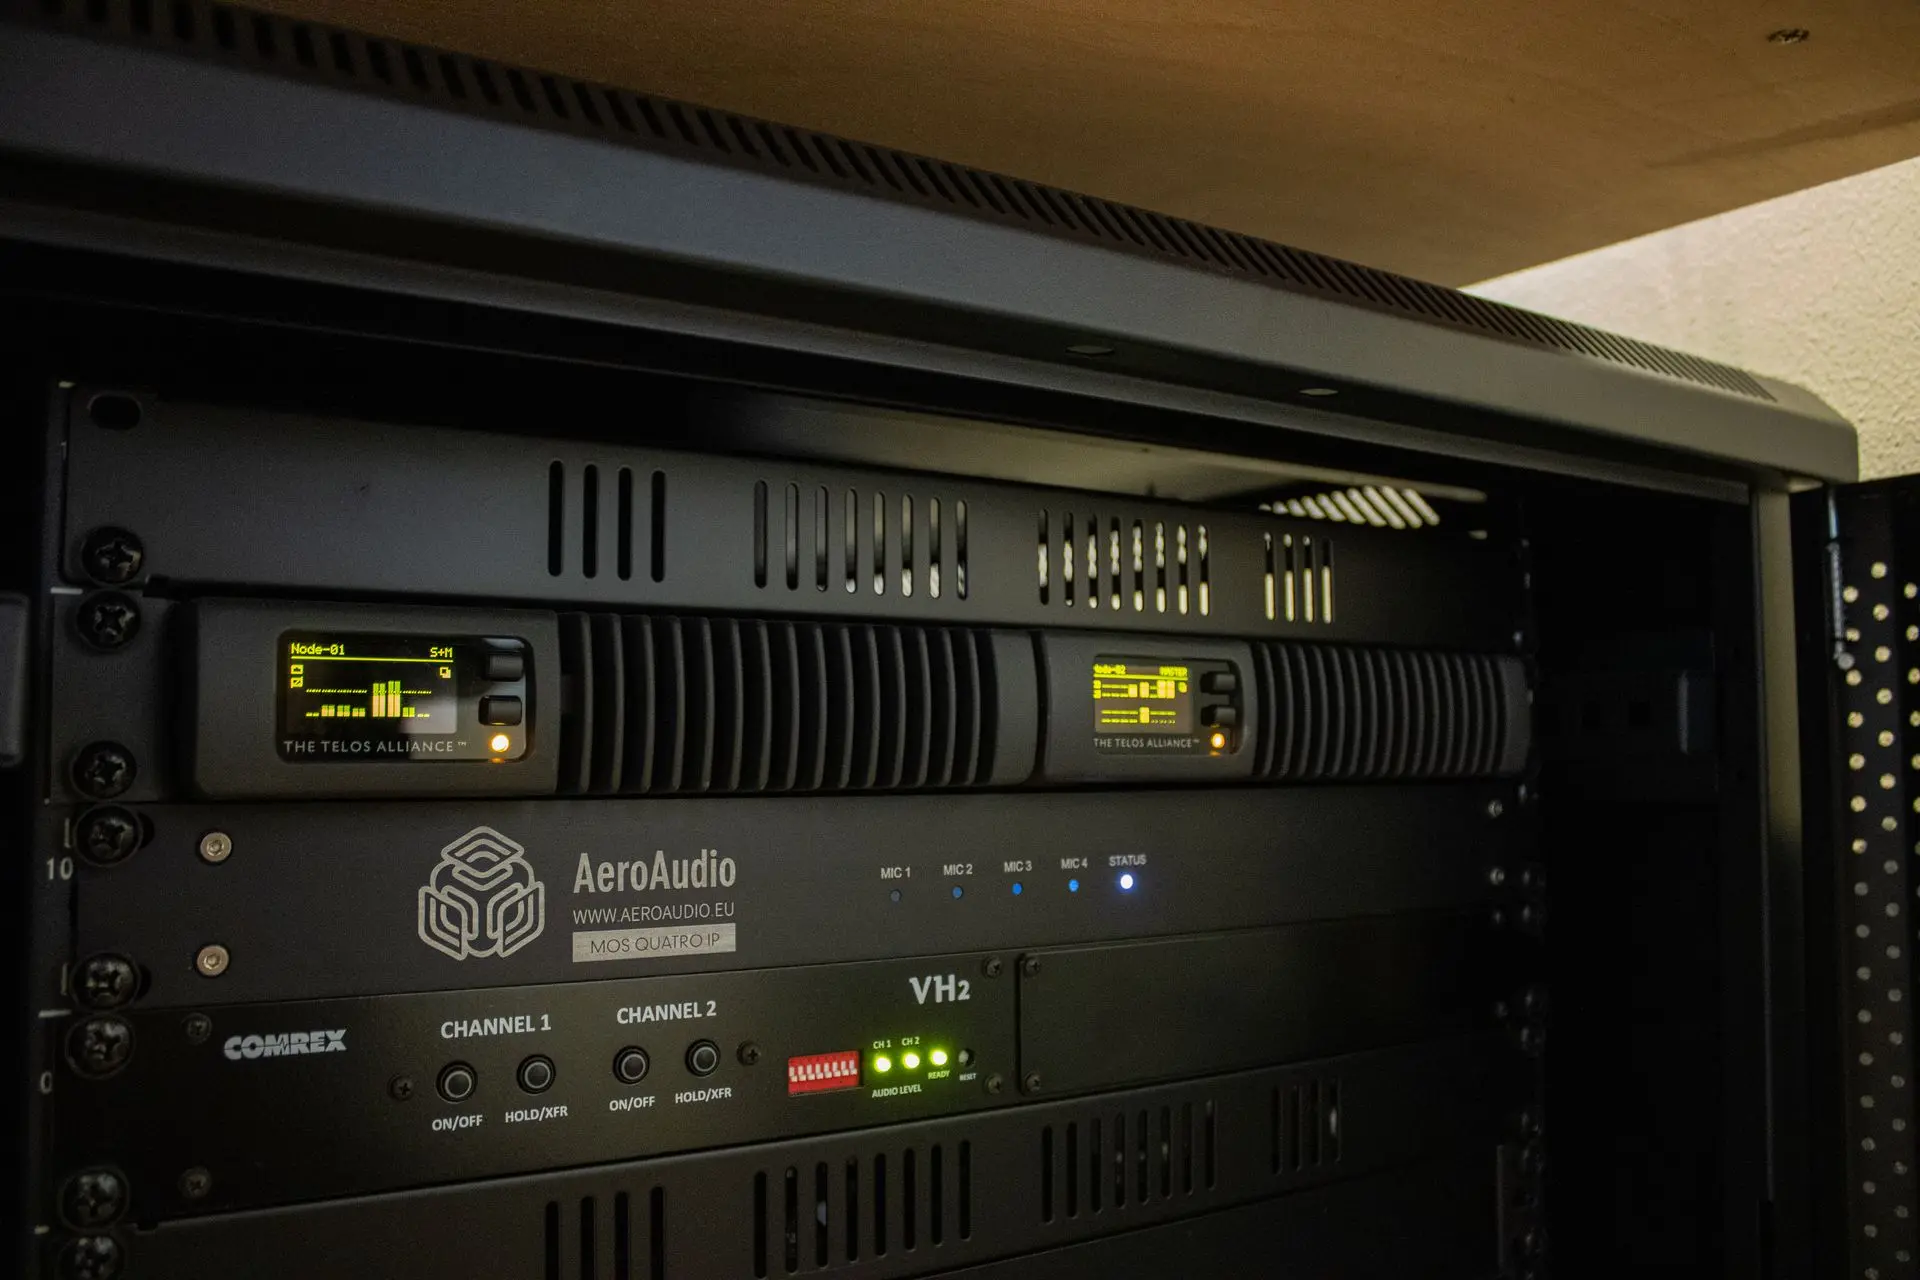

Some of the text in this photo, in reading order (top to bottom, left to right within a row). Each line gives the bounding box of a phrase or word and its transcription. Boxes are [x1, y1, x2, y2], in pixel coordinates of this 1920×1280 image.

[291, 643, 345, 656] Node-01
[430, 647, 453, 658] S+M
[284, 740, 315, 753] THE
[321, 740, 370, 753] TELOS
[1093, 738, 1112, 748] THE
[1114, 738, 1144, 748] TELOS
[1004, 860, 1032, 873] MIC 3
[1061, 857, 1088, 870] MIC 4
[1109, 854, 1147, 867] STATUS
[47, 857, 73, 880] 10
[573, 849, 737, 894] AeroAudio
[881, 867, 911, 879] MIC 1
[943, 863, 973, 876] MIC 2
[573, 902, 734, 924] WWW.AEROAUDIO.EU
[591, 933, 720, 954] MOS QUATRO IP
[909, 974, 970, 1005] VH2
[616, 1001, 716, 1024] CHANNEL 2
[440, 1014, 551, 1039] CHANNEL 1
[224, 1029, 347, 1060] COMREX
[873, 1040, 885, 1049] CH
[902, 1036, 920, 1046] CH 2
[928, 1071, 950, 1080] READY
[675, 1087, 732, 1104] HOLD/XFR
[872, 1084, 922, 1099] AUDIO LEVEL
[609, 1096, 655, 1112] ON/OFF
[505, 1105, 568, 1123] HOLD/XFR
[432, 1115, 483, 1132] ON/OFF
